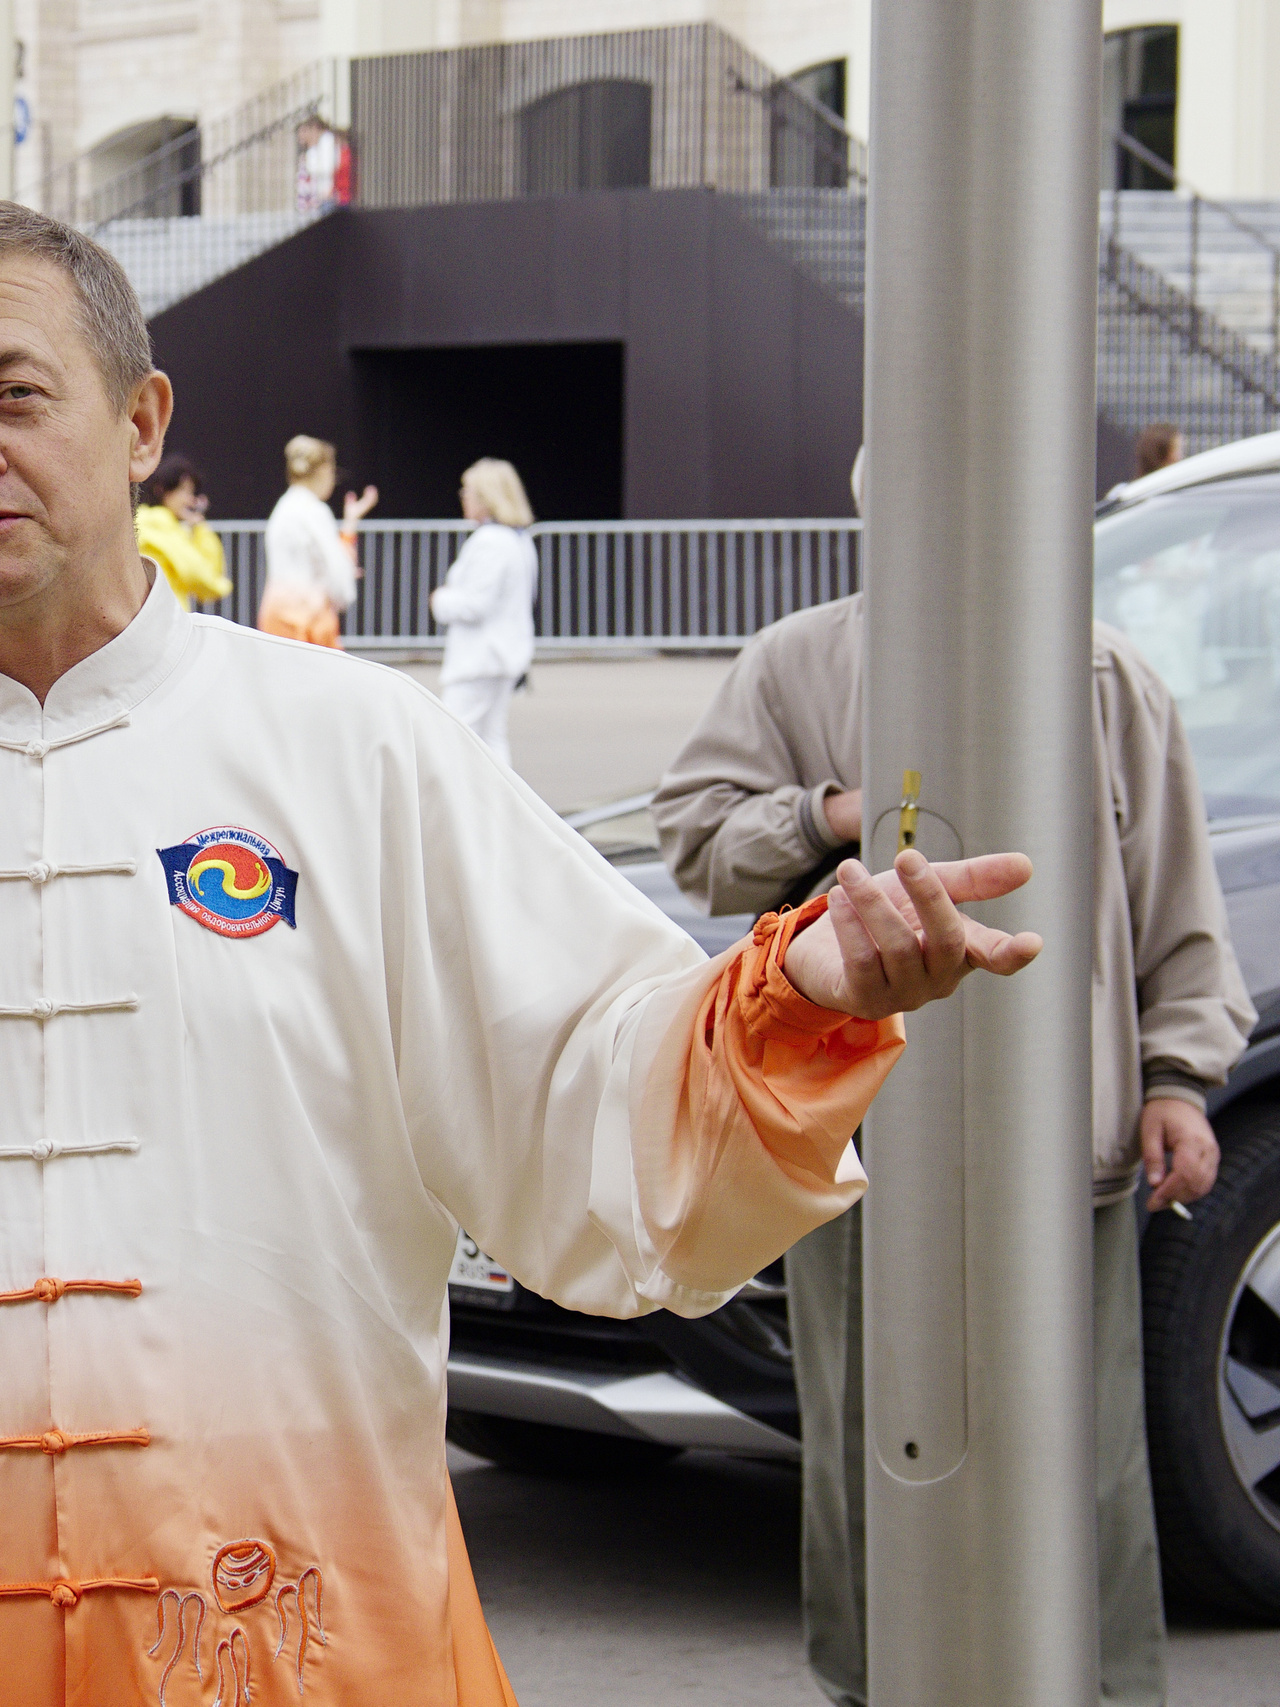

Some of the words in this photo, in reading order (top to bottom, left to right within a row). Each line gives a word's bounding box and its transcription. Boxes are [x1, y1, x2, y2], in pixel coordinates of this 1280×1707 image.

[196, 829, 270, 856] Межрегиональная
[174, 870, 200, 913] Ассоциация
[202, 911, 273, 931] оздоровительного
